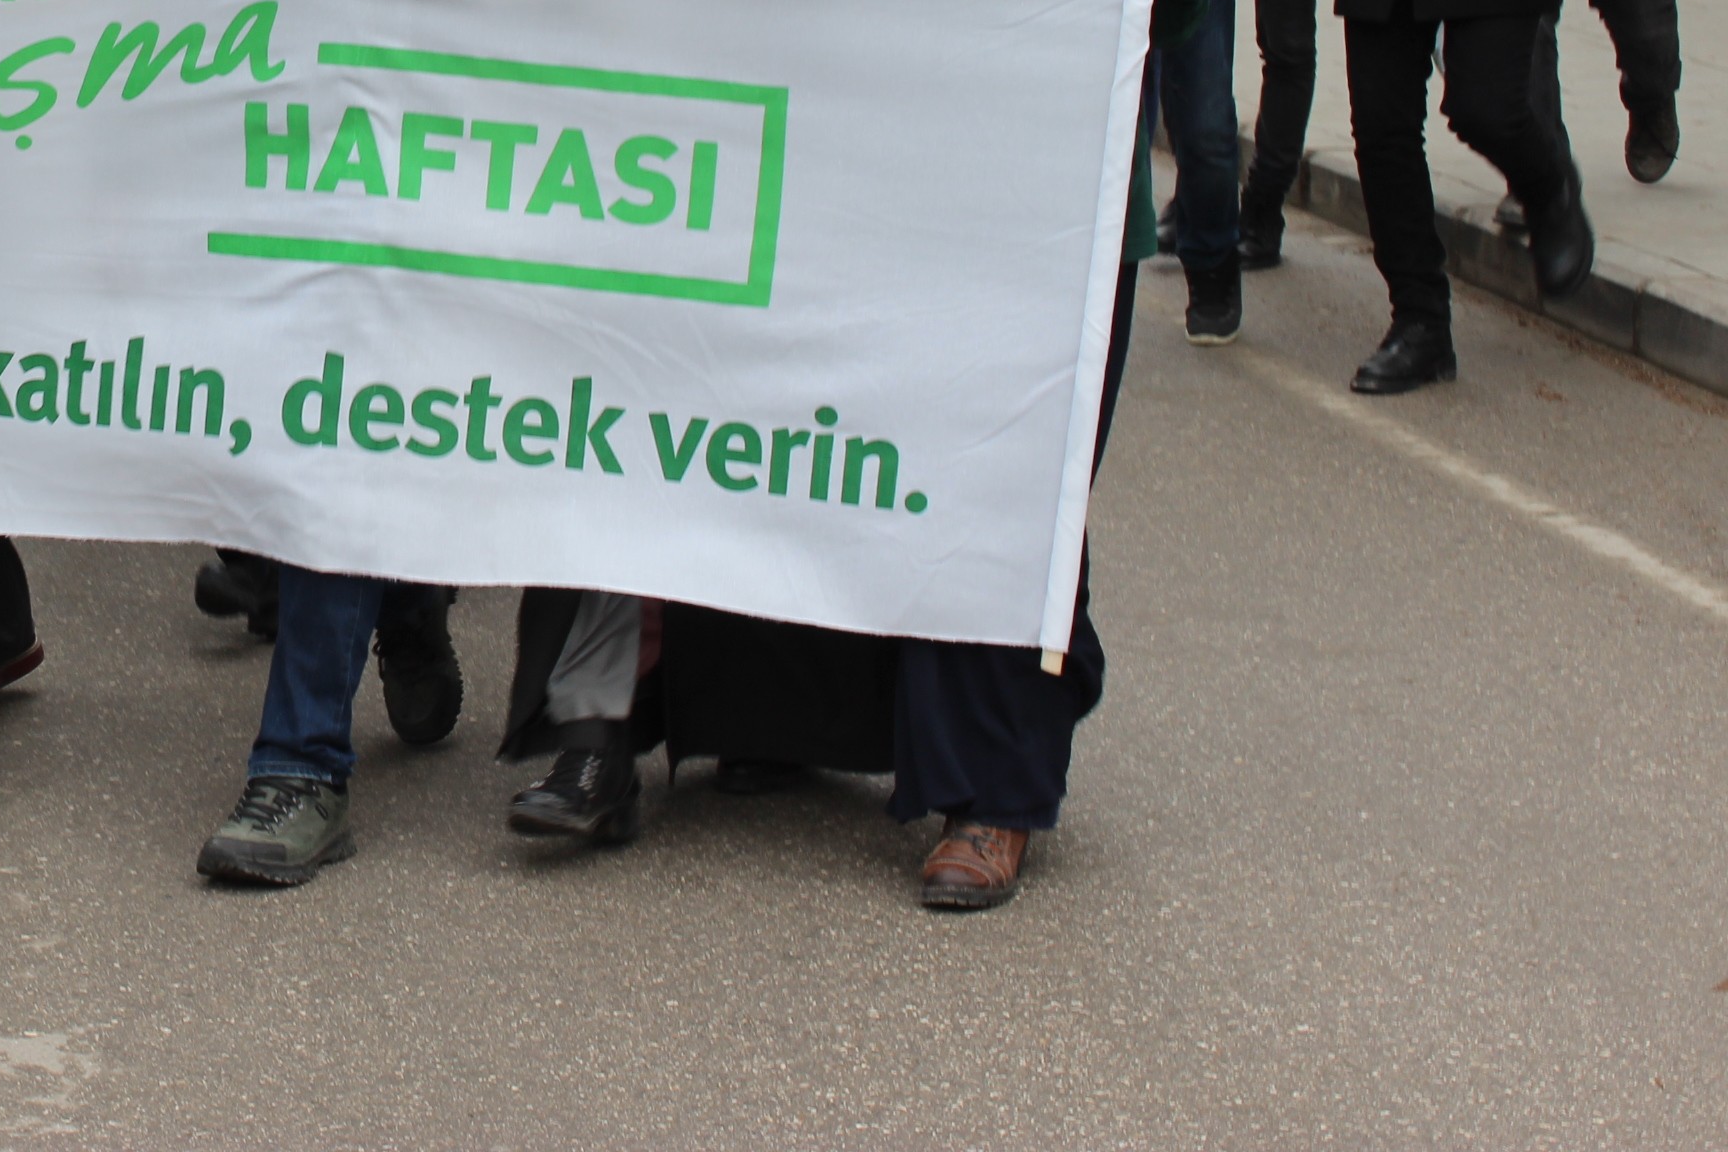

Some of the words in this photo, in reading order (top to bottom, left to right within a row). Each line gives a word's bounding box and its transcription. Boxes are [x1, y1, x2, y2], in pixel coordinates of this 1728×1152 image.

[243, 99, 720, 233] HAFTASI
[281, 351, 625, 475] destek
[650, 406, 929, 514] verin.
